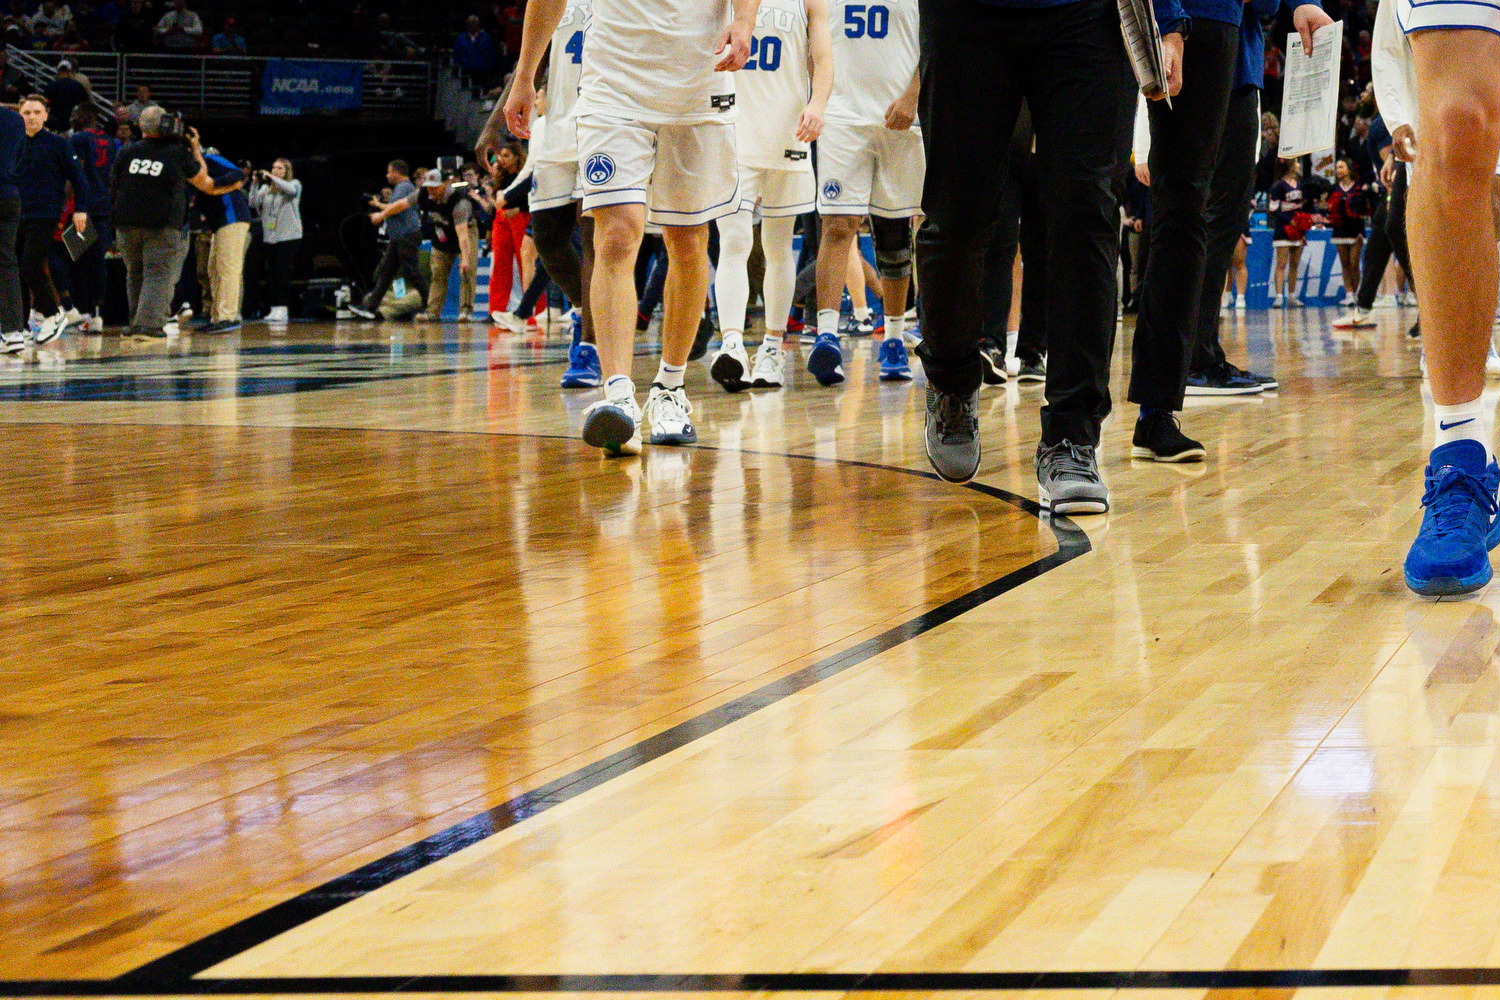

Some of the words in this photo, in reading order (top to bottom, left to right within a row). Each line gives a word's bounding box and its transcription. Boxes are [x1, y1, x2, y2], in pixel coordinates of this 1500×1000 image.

[557, 4, 593, 30] BY
[756, 6, 795, 33] YU
[844, 4, 889, 39] 50
[129, 158, 164, 177] 629
